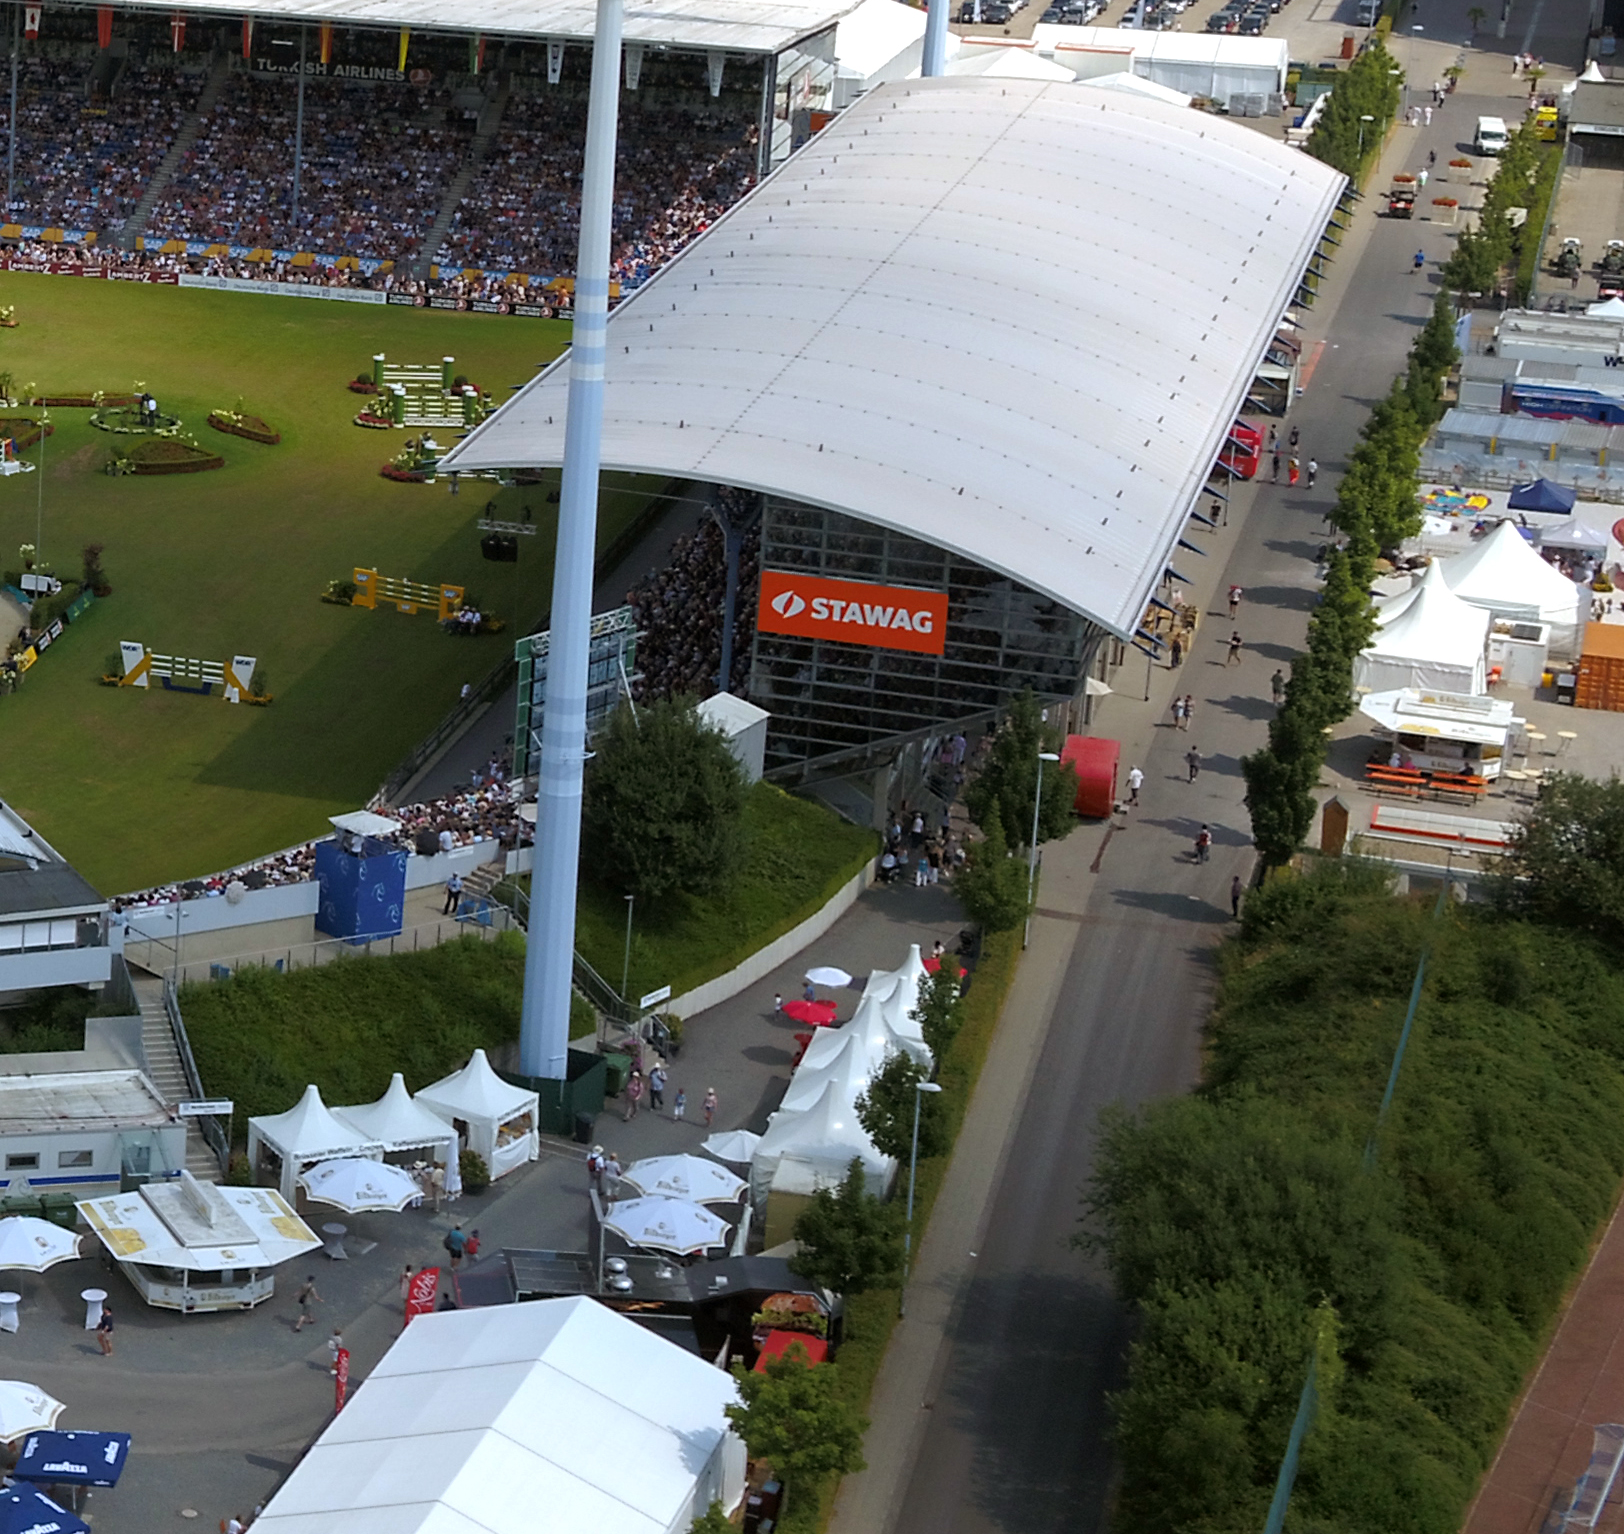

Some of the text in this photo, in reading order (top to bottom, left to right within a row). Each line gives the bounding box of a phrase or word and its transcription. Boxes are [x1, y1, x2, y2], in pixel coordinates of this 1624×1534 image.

[334, 64, 406, 82] AIRLINES
[22, 228, 40, 238] SAP
[64, 232, 83, 243] SAP
[144, 239, 162, 251] SAP
[187, 244, 205, 256] SAP
[230, 248, 248, 259] SAP
[8, 259, 52, 274] LAMBERTZ
[316, 256, 335, 267] SAP
[107, 269, 151, 283] LAMBERTZ
[439, 268, 458, 277] SAP
[529, 276, 548, 285] SAP
[811, 597, 932, 634] STAWAG
[327, 1146, 353, 1156] Waffeln
[42, 1461, 88, 1474] LAVAZZA
